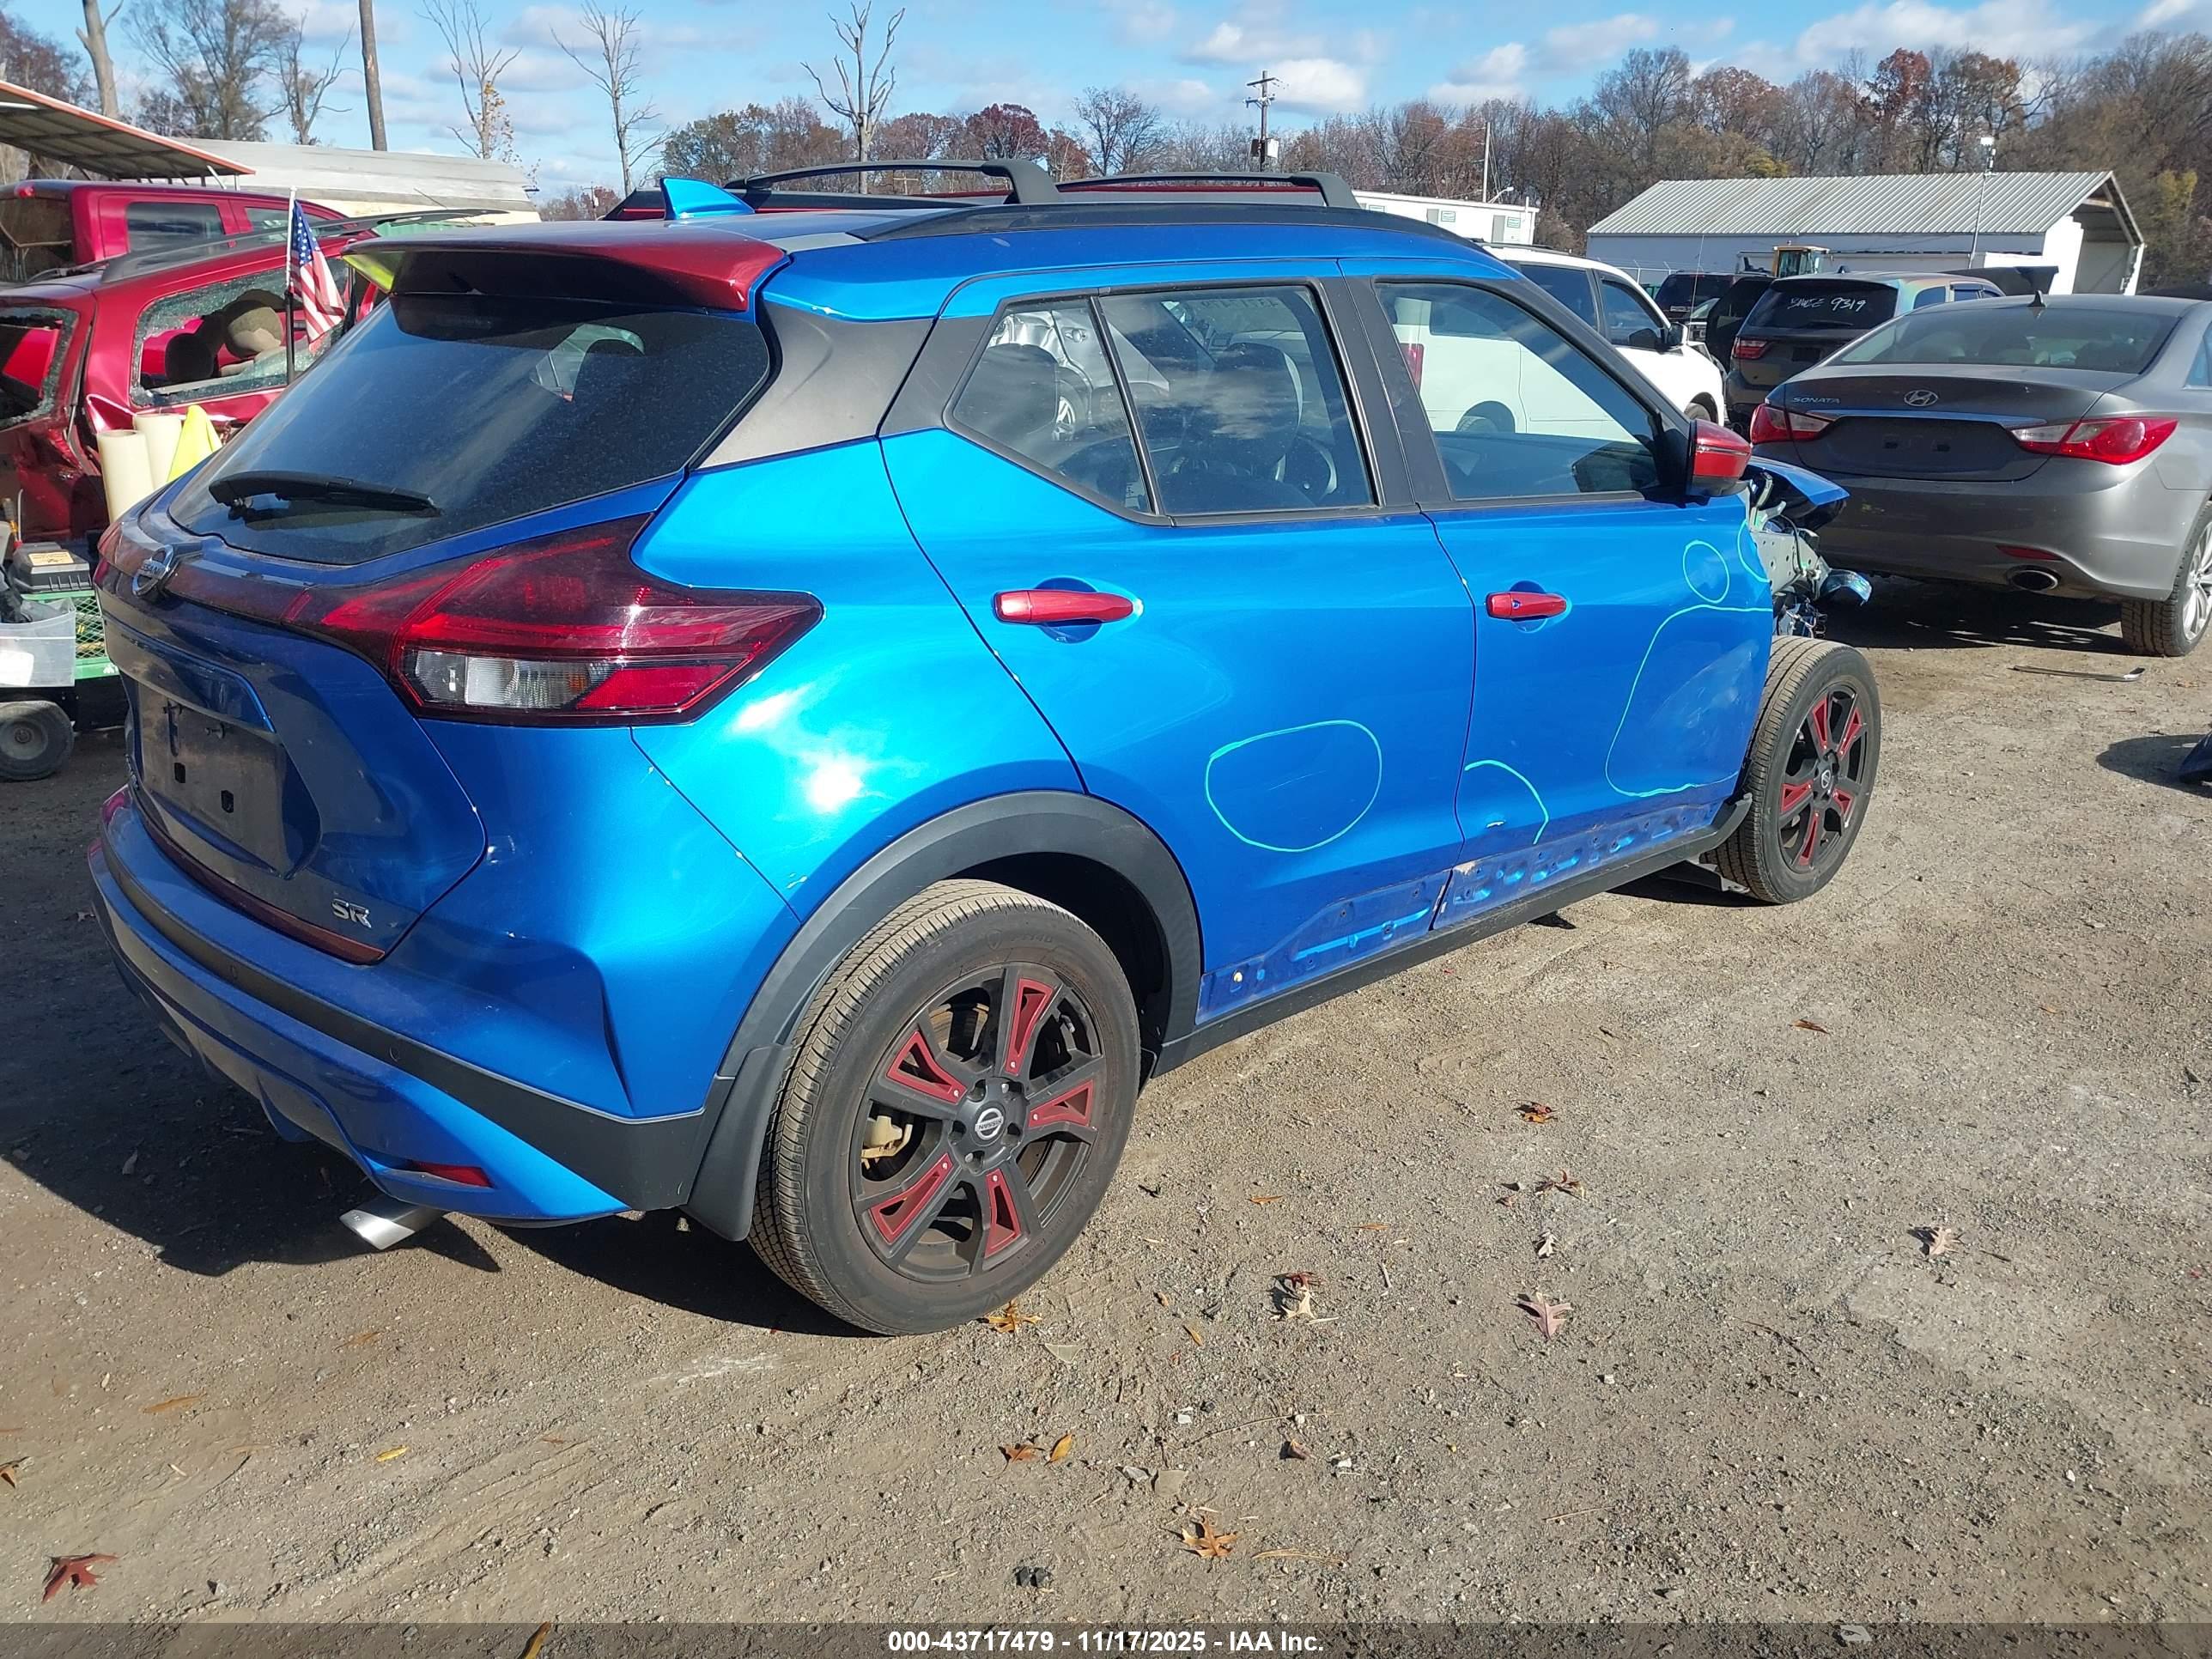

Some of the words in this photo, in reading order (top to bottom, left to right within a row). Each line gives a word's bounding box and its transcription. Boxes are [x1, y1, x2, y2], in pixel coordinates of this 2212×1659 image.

[1831, 297, 1866, 312] 9319
[331, 898, 372, 928] SR
[978, 1118, 1002, 1129] NISSAN
